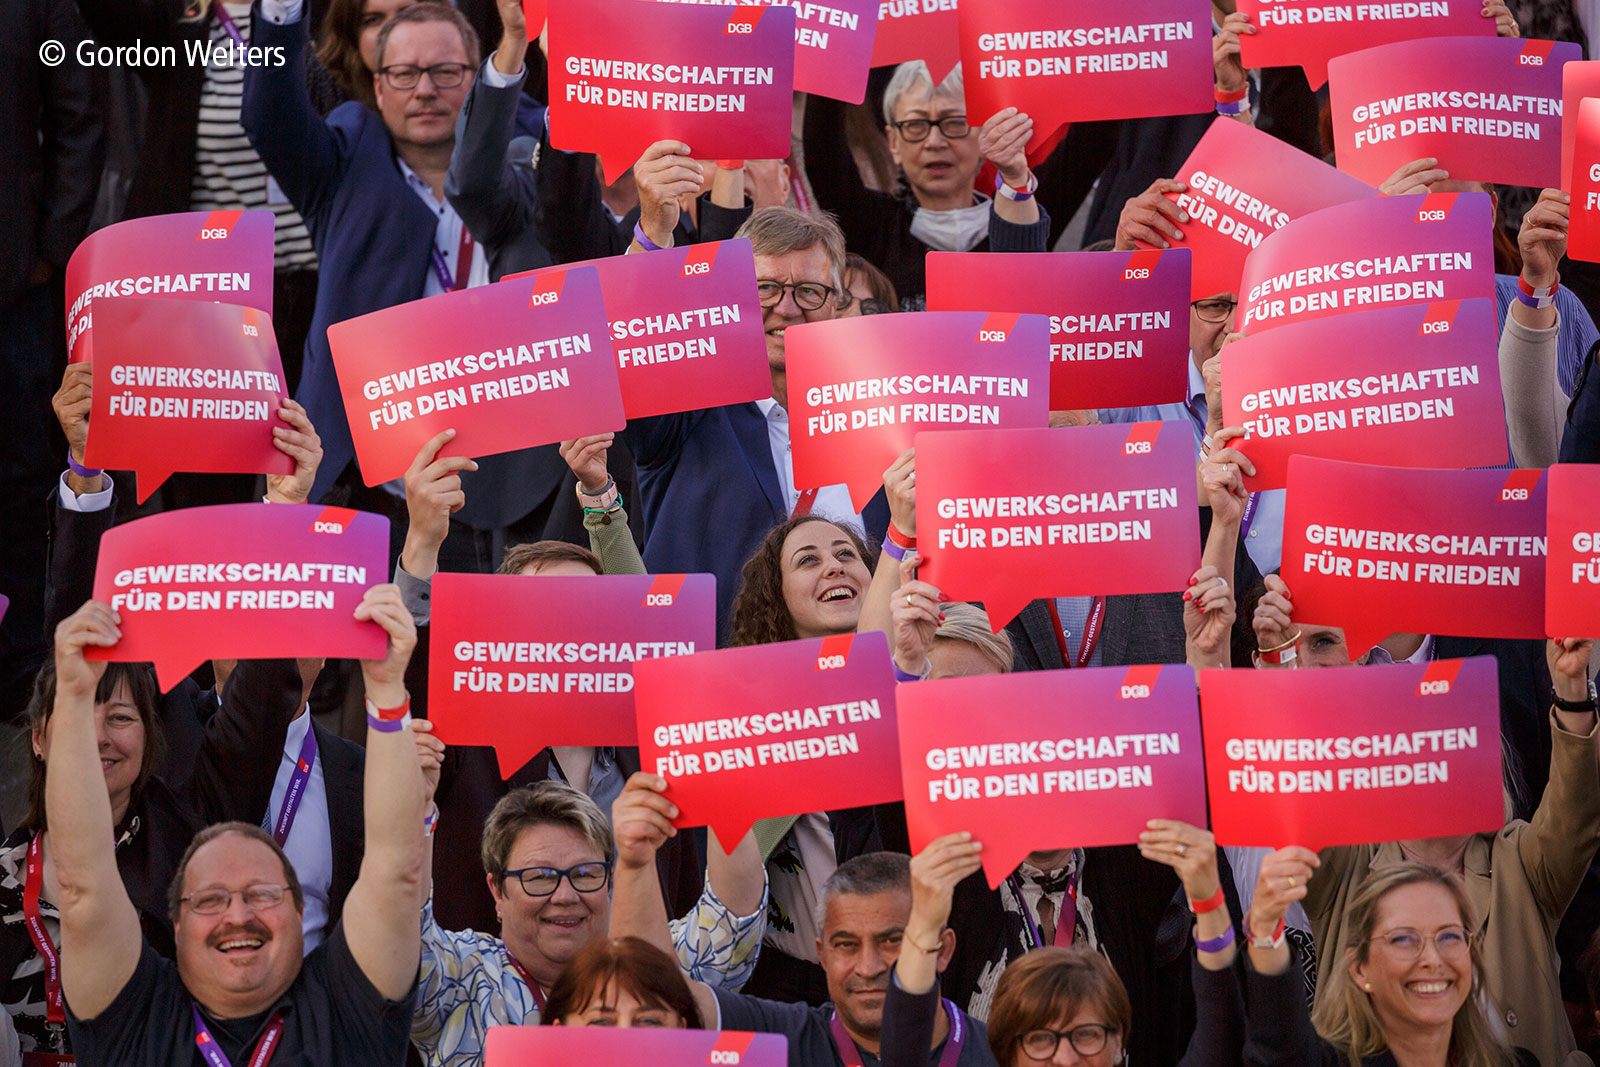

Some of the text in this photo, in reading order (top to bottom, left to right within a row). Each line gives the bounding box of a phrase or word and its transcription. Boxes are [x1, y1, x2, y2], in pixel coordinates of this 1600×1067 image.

[878, 0, 919, 20] FÜR
[922, 0, 957, 13] DE
[1259, 2, 1448, 26] FÜR DEN FRIEDEN
[728, 23, 752, 33] DGB
[979, 22, 1192, 51] GEWERKSCHAFTEN
[566, 57, 773, 85] GEWERKSCHAFTEN
[980, 51, 1167, 78] FÜR DEN FRIEDEN
[1520, 55, 1543, 65] DGB
[567, 80, 745, 111] FÜR DEN FRIEDEN
[1352, 92, 1563, 123] GEWERKSCHAFTEN
[1355, 116, 1539, 148] FÜR DEN FRIEDEN
[1189, 171, 1290, 230] GEWERKS
[1177, 194, 1263, 249] FÜR DEN
[1420, 211, 1445, 221] DGB
[202, 229, 227, 239] DGB
[685, 263, 709, 275] DGB
[1126, 269, 1149, 279] DGB
[1248, 252, 1471, 303] GEWERKSCHAFTEN
[532, 292, 558, 305] DGB
[1244, 280, 1444, 326] FÜR DEN FRIEDEN
[243, 324, 258, 336] DGB
[608, 304, 741, 340] SCHAFTEN
[1047, 311, 1170, 334] SCHAFTEN
[1423, 321, 1449, 333] DGB
[980, 331, 1005, 342] DGB
[618, 337, 716, 368] FRIEDEN
[1049, 340, 1142, 361] FRIEDEN
[111, 366, 280, 393] GEWERKSCHAFTEN
[364, 334, 591, 401] GEWERKSCHAFTEN
[370, 368, 569, 430] FÜR DEN FRIEDEN
[807, 375, 1028, 406] GEWERKSCHAFTEN
[1241, 366, 1479, 413] GEWERKSCHAFTEN
[110, 391, 268, 420] FÜR DEN FRIEDEN
[1242, 398, 1454, 440] FÜR DEN FRIEDEN
[809, 404, 999, 436] FÜR DEN FRIEDEN
[1126, 442, 1151, 454] DGB
[938, 488, 1177, 518] GEWERKSCHAFTEN
[1503, 489, 1528, 500] DGB
[315, 522, 342, 534] DGB
[939, 520, 1151, 549] FÜR DEN FRIEDEN
[1306, 524, 1547, 556] GEWERKSCHAFTEN
[114, 563, 366, 586] GEWERKSCHAFTEN
[1304, 550, 1520, 585] FÜR DEN FRIEDEN
[1572, 557, 1600, 584] FÜ
[111, 588, 334, 611] FÜR DEN FRIEDEN
[647, 594, 672, 606] DGB
[454, 642, 694, 662] GEWERKSCHAFTEN
[818, 655, 845, 669] DGB
[1080, 637, 1092, 663] ZUKUNFT
[454, 667, 634, 692] FÜR DEN FRIED
[1121, 685, 1149, 698] DGB
[1421, 680, 1449, 695] DGB
[654, 699, 881, 748] GEWERKSCHAFTEN
[656, 733, 858, 779] FÜR DEN FRIEDEN
[926, 733, 1179, 770] GEWERKSCHAFTEN
[1226, 727, 1477, 761] GEWERKSCHAFTEN
[929, 765, 1152, 802] FÜR DEN FRIEDEN
[1229, 761, 1448, 793] FÜR DEN FRIEDEN
[711, 1051, 739, 1064] DGB
